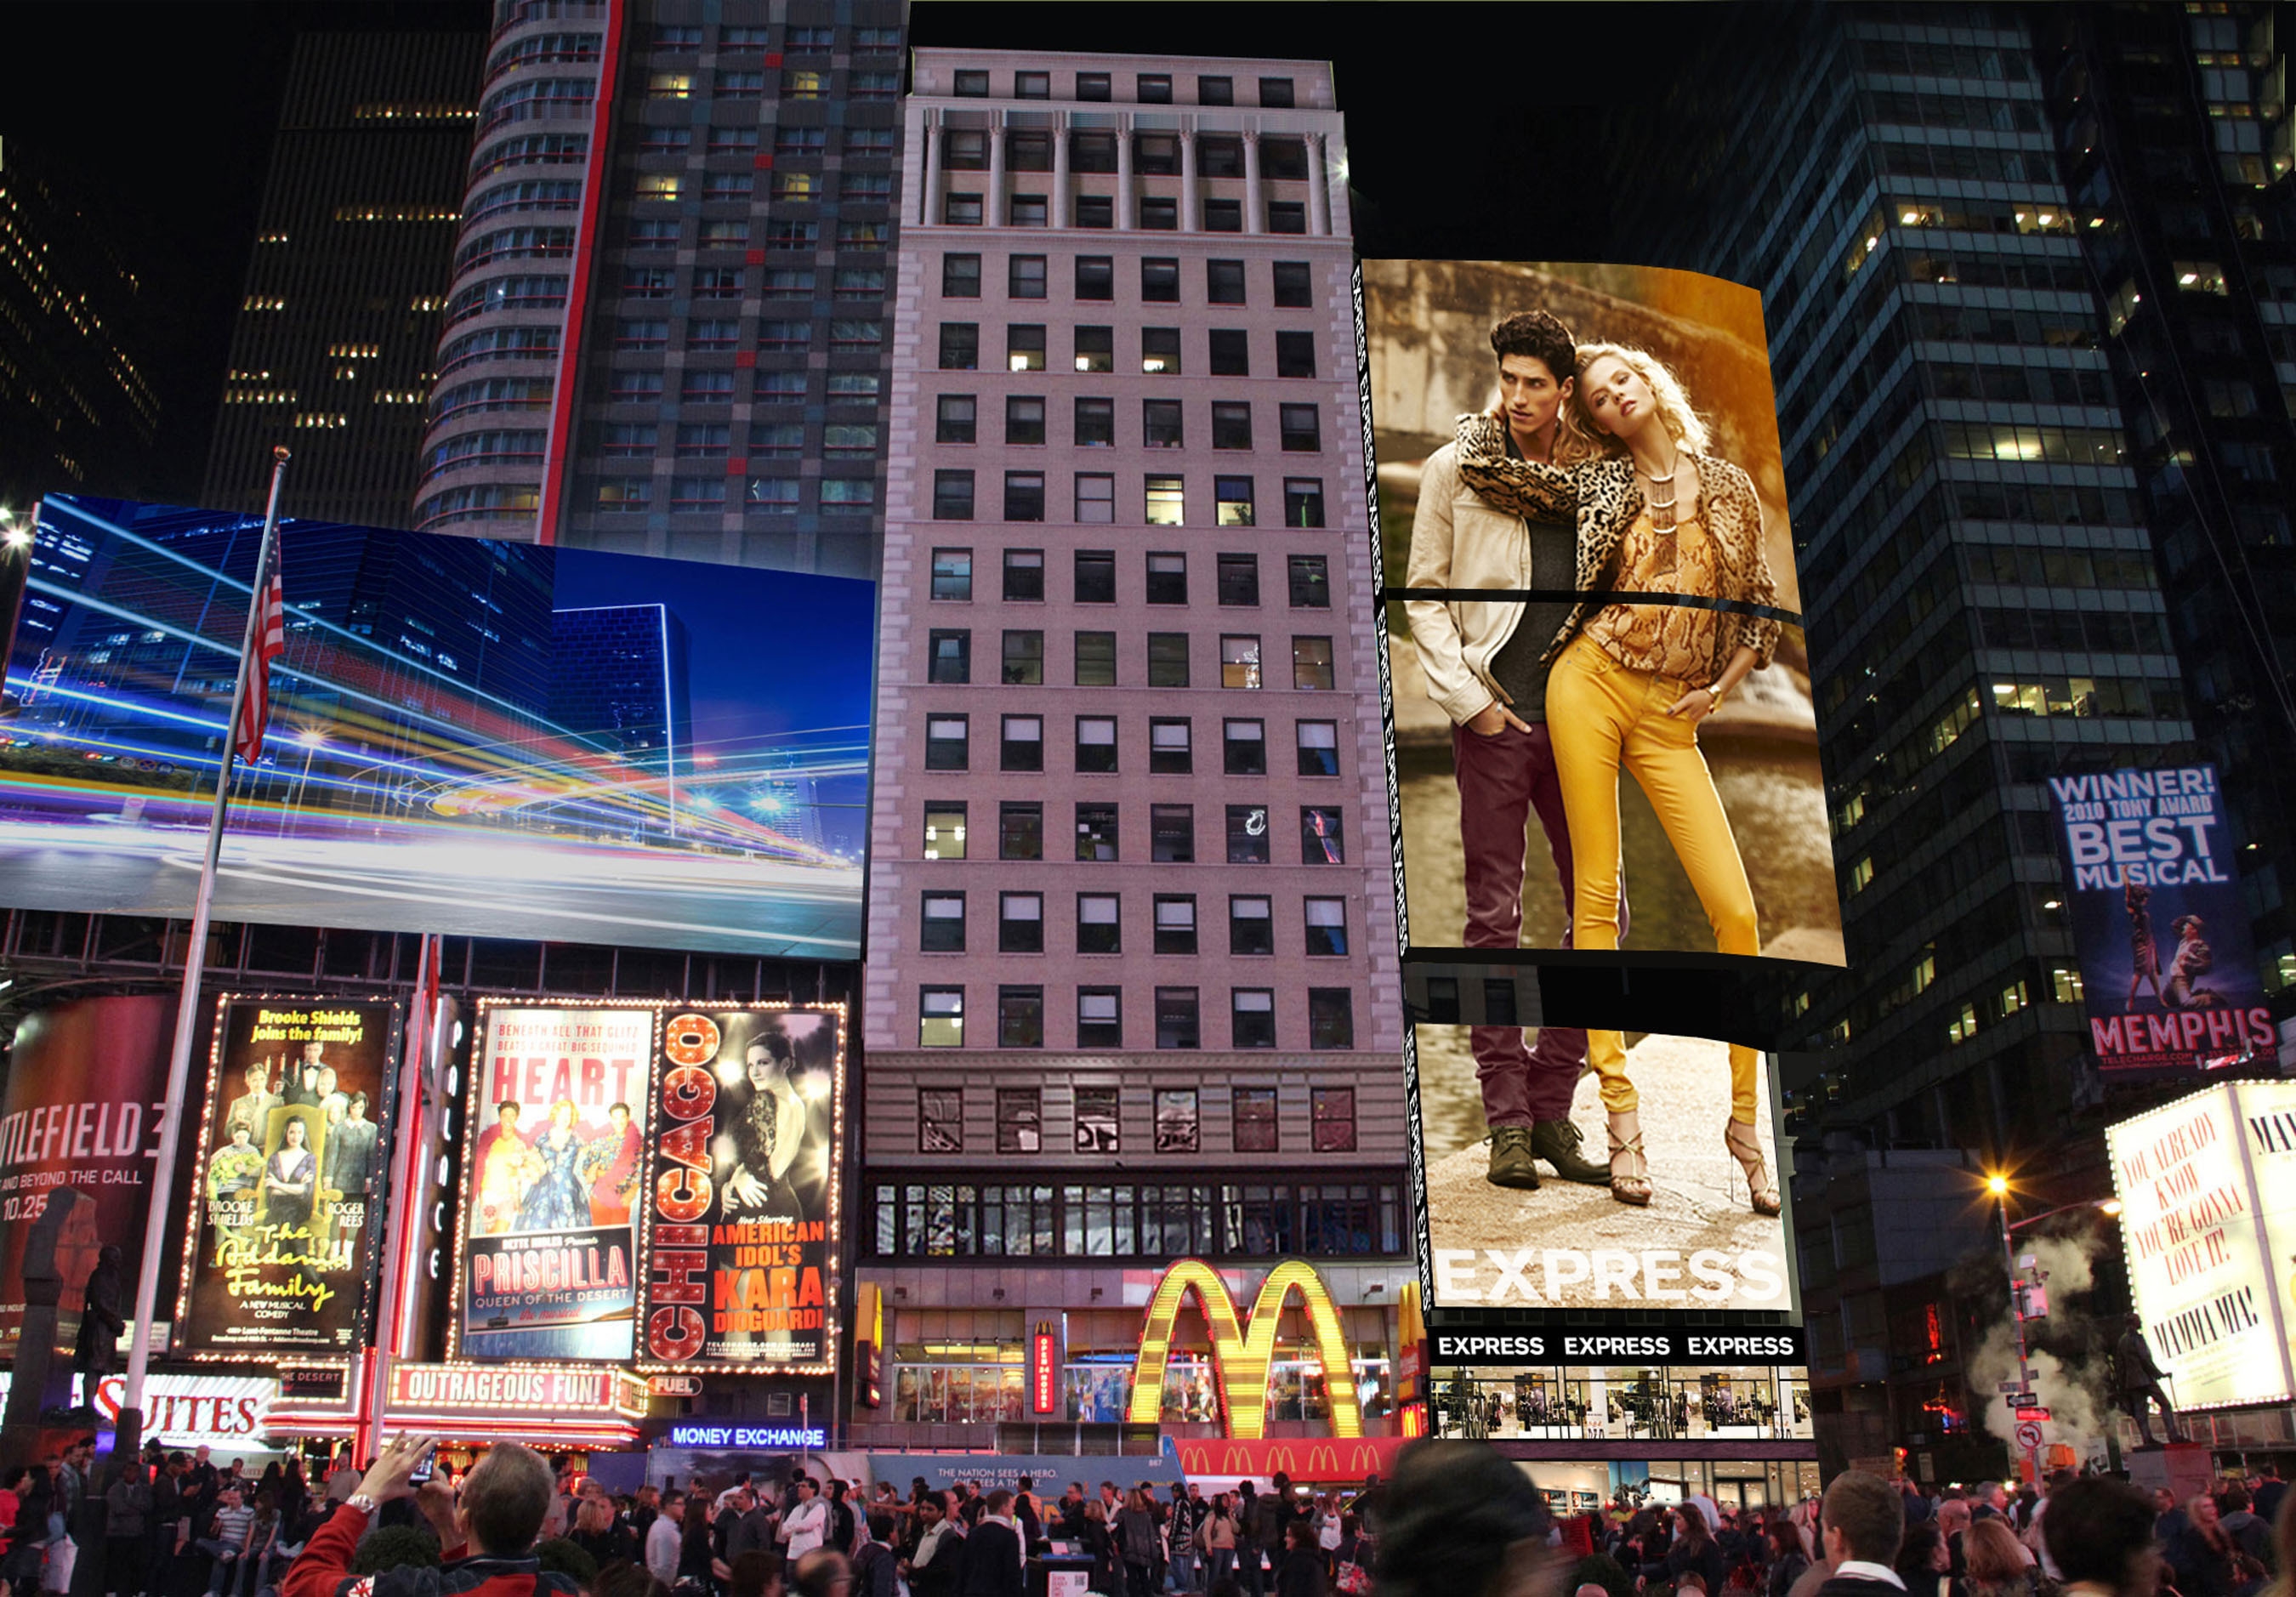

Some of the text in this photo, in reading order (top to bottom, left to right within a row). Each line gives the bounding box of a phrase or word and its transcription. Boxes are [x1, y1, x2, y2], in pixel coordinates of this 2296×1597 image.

[1351, 264, 1408, 957] EXPRESS EXPRESS EXPRESS EXPRESS EXPRESS EXPRESS
[2049, 767, 2215, 803] WINNER!
[2064, 794, 2214, 822] 2010 TONY AWARD
[2066, 814, 2216, 866] BEST
[2075, 858, 2229, 891] MUSICAL
[259, 1009, 361, 1026] Brooke Shields
[288, 1026, 312, 1040] the
[313, 1027, 363, 1045] family!
[552, 1025, 571, 1037] ALL
[576, 1025, 602, 1038] THAT
[607, 1026, 639, 1038] GLITZ
[2090, 1007, 2276, 1055] MEMPHIS
[497, 1040, 526, 1051] BEATS
[571, 1041, 587, 1052] BIG
[0, 1102, 143, 1168] TTLEFIELD
[429, 1020, 462, 1279] PALACE
[1409, 1092, 1424, 1207] EXPRESS
[2122, 1111, 2215, 1188] YOU ALREADY
[20, 1170, 65, 1188] BEYOND
[70, 1169, 98, 1184] THE
[102, 1169, 143, 1185] CALL
[648, 1013, 721, 1361] CHICAGO
[2155, 1162, 2200, 1211] KNOW
[207, 1201, 253, 1213] BROOKE
[327, 1202, 365, 1215] ROGER
[207, 1213, 254, 1226] SHIELDS
[339, 1215, 364, 1228] REES
[757, 1215, 793, 1225] Starring
[2134, 1184, 2243, 1259] YOU'RE GONNA
[254, 1222, 312, 1244] The
[712, 1220, 825, 1245] AMERICAN
[736, 1244, 802, 1267] IDOL'S
[2165, 1227, 2231, 1286] LOVE IT!
[474, 1246, 628, 1296] PRISCILLA
[1434, 1248, 1783, 1301] EXPRESS
[224, 1268, 335, 1312] Family
[475, 1288, 628, 1310] QUEEN OF THE DESERT
[713, 1266, 824, 1310] KARA
[254, 1310, 289, 1319] COMEDY
[269, 1301, 306, 1310] MUSICAL
[538, 1305, 583, 1320] musical
[713, 1309, 824, 1333] DIOGUARDI
[2154, 1304, 2218, 1359] MAMMA
[2214, 1285, 2259, 1334] MIA!
[1439, 1337, 1794, 1355] EXPRESS EXPRESS EXPRESS
[298, 1372, 340, 1382] DESERT
[408, 1371, 544, 1403] OUTRAGEOUS
[554, 1373, 600, 1404] FUN!
[655, 1378, 693, 1393] FUEL
[673, 1428, 824, 1446] MONEY EXCHANGE
[939, 1469, 1058, 1478] THE NATION SEES A HERO.
[997, 1478, 1004, 1487] A
